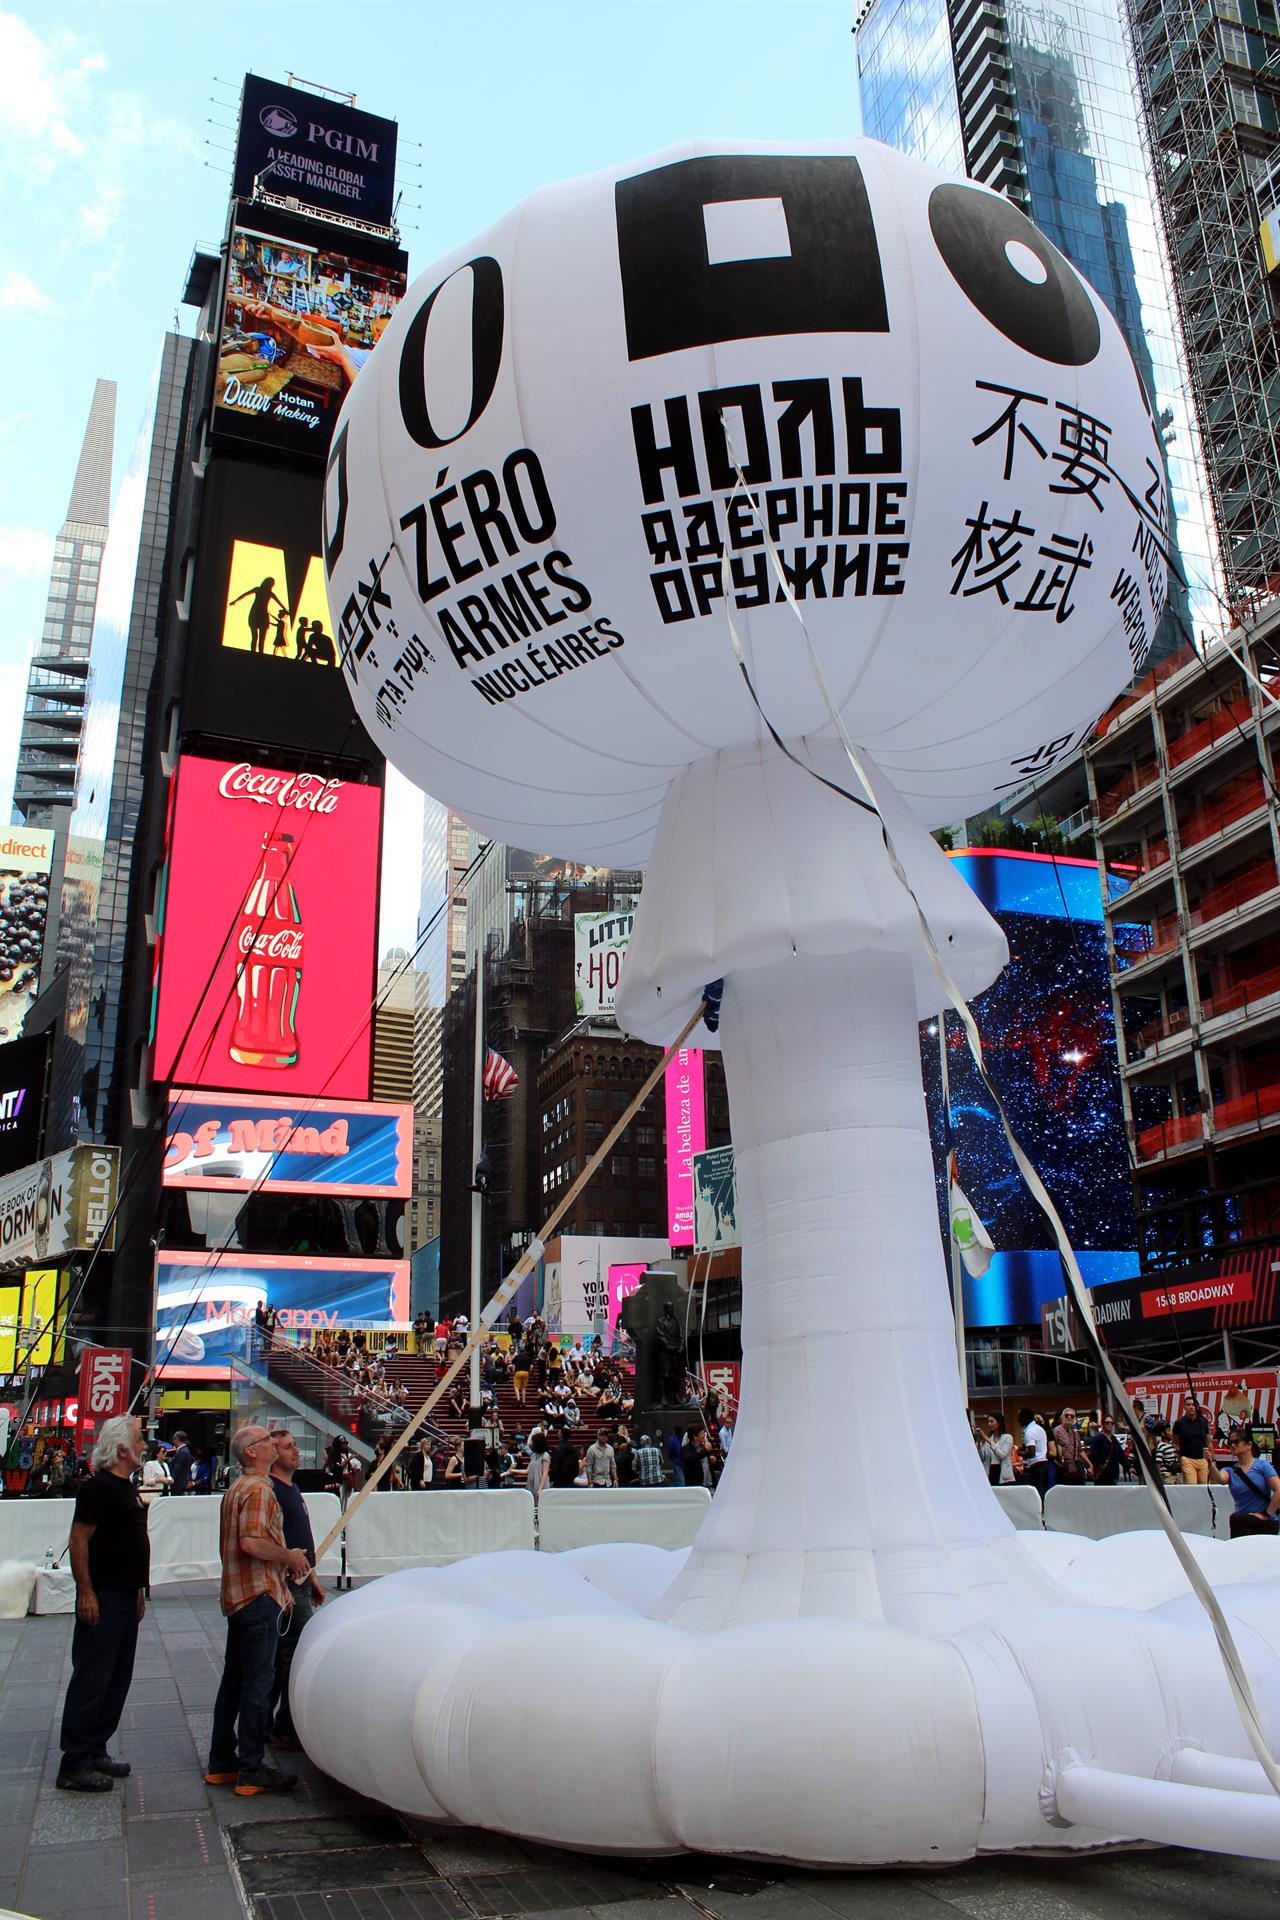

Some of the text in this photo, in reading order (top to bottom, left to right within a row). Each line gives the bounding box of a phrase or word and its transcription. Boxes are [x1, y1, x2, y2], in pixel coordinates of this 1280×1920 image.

[267, 147, 366, 189] A LEADING GLOBAL
[306, 122, 379, 163] PGIM
[269, 163, 362, 201] ASSET MANAGER.
[398, 256, 503, 450] 0
[223, 376, 271, 413] Dutar
[274, 404, 320, 429] Making
[278, 391, 315, 409] Hotan
[630, 376, 903, 506] НОЛЬ
[971, 380, 1112, 514] 不要
[399, 446, 557, 605] ZÉRO
[641, 482, 908, 566] ЯДЕРНОЕ
[649, 542, 911, 625] ОРУЖИЕ
[949, 500, 1095, 624] 核武
[436, 550, 592, 670] ARMES
[1110, 567, 1150, 676] WEAPONS
[470, 616, 625, 706] NUCLÉAIRES
[218, 762, 346, 814] Coca-Cola
[676, 1074, 690, 1094] de
[227, 1116, 350, 1158] Mind
[677, 1098, 692, 1153] belleza
[679, 1157, 692, 1178] La
[6, 1190, 26, 1213] BOOK
[27, 1184, 37, 1201] OF
[85, 1151, 112, 1244] HELLO!
[1178, 1283, 1235, 1305] BROADWAY
[1045, 1295, 1076, 1354] TSX
[91, 1354, 123, 1413] tkts
